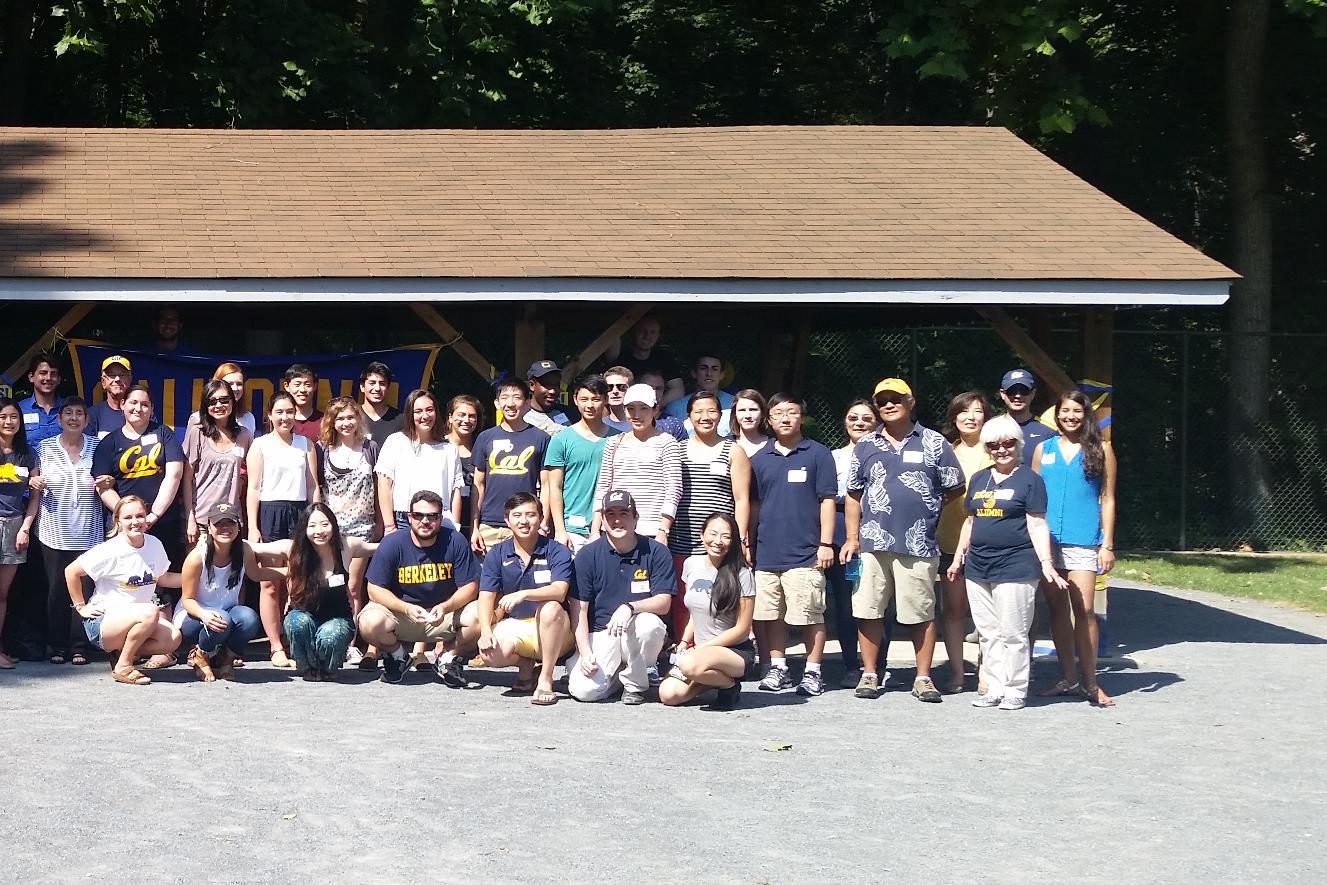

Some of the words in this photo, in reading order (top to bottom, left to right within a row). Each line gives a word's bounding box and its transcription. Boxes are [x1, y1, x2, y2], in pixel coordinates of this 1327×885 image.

[119, 442, 163, 479] Cal
[488, 440, 536, 476] Cal
[976, 508, 1005, 518] ALUMNI
[398, 563, 453, 584] BERKELEY
[633, 569, 648, 580] Cal
